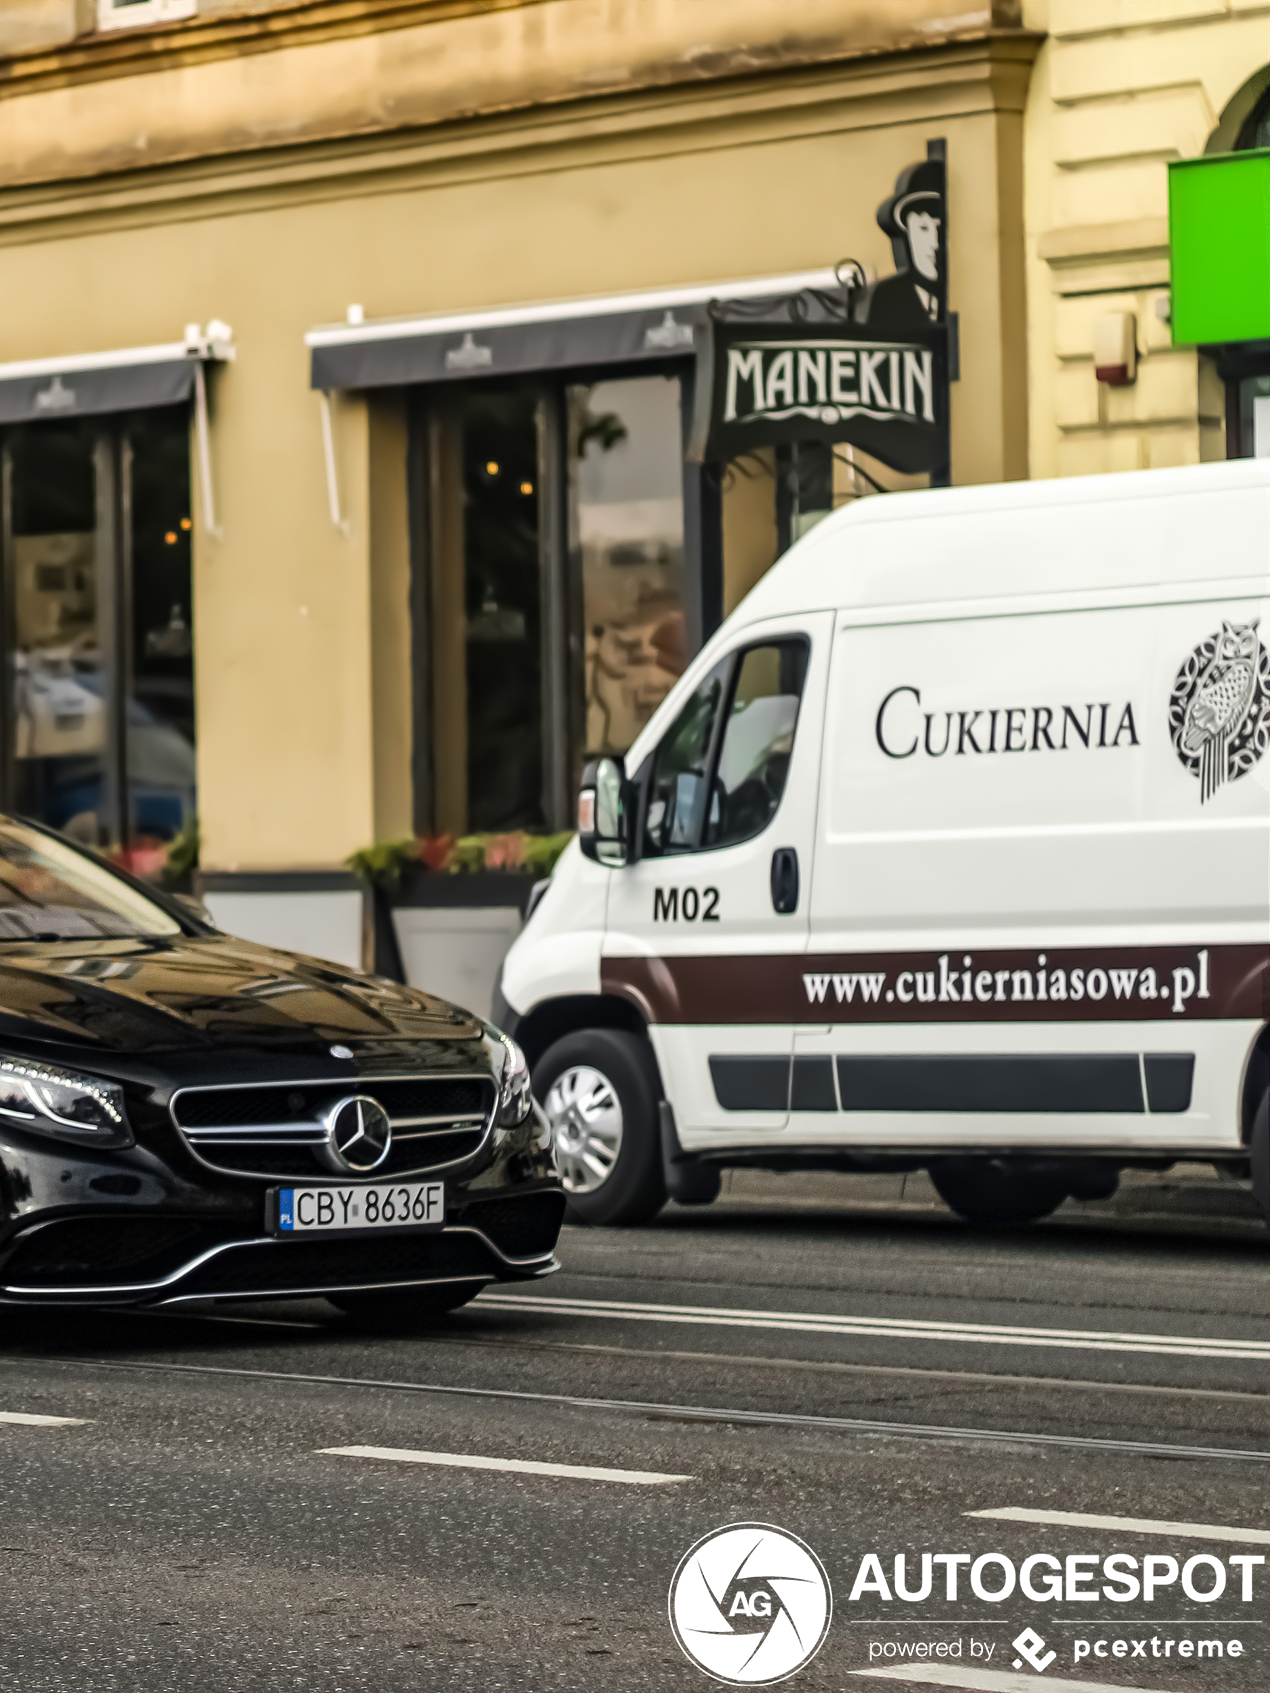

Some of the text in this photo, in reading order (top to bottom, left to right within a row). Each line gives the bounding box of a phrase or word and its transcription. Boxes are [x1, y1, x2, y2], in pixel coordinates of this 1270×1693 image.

[724, 350, 935, 423] MANEKIN
[875, 686, 1141, 759] CUKIERNIA
[653, 886, 720, 922] M02
[802, 949, 1211, 1013] www.cukierniasowa.pl
[281, 1214, 292, 1224] PL
[297, 1186, 441, 1226] CBY 8636F
